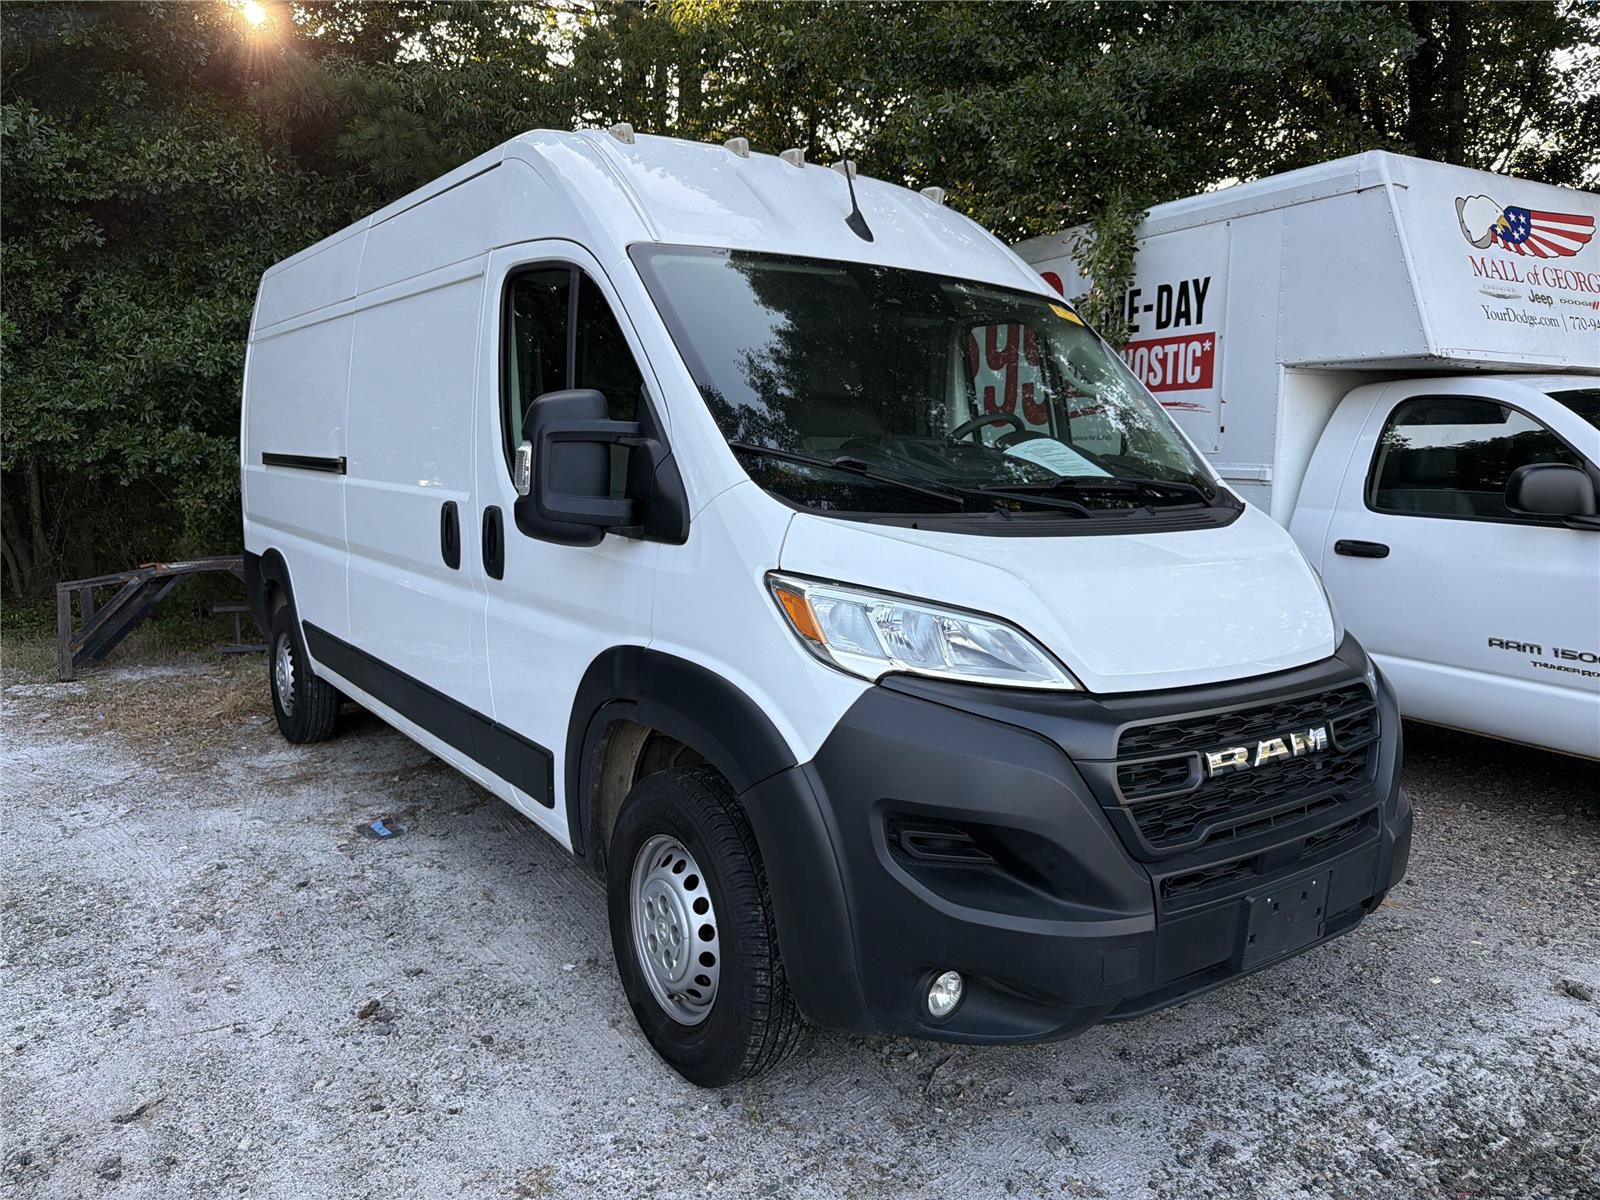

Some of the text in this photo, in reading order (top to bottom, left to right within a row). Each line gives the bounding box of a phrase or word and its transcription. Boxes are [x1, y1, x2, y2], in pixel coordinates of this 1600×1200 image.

[1468, 255, 1600, 294] MALL of GEORG
[1528, 289, 1554, 307] Jeep
[1481, 304, 1560, 328] YourDodge.com
[1488, 637, 1600, 664] RAM 150
[1204, 726, 1328, 778] RAM
